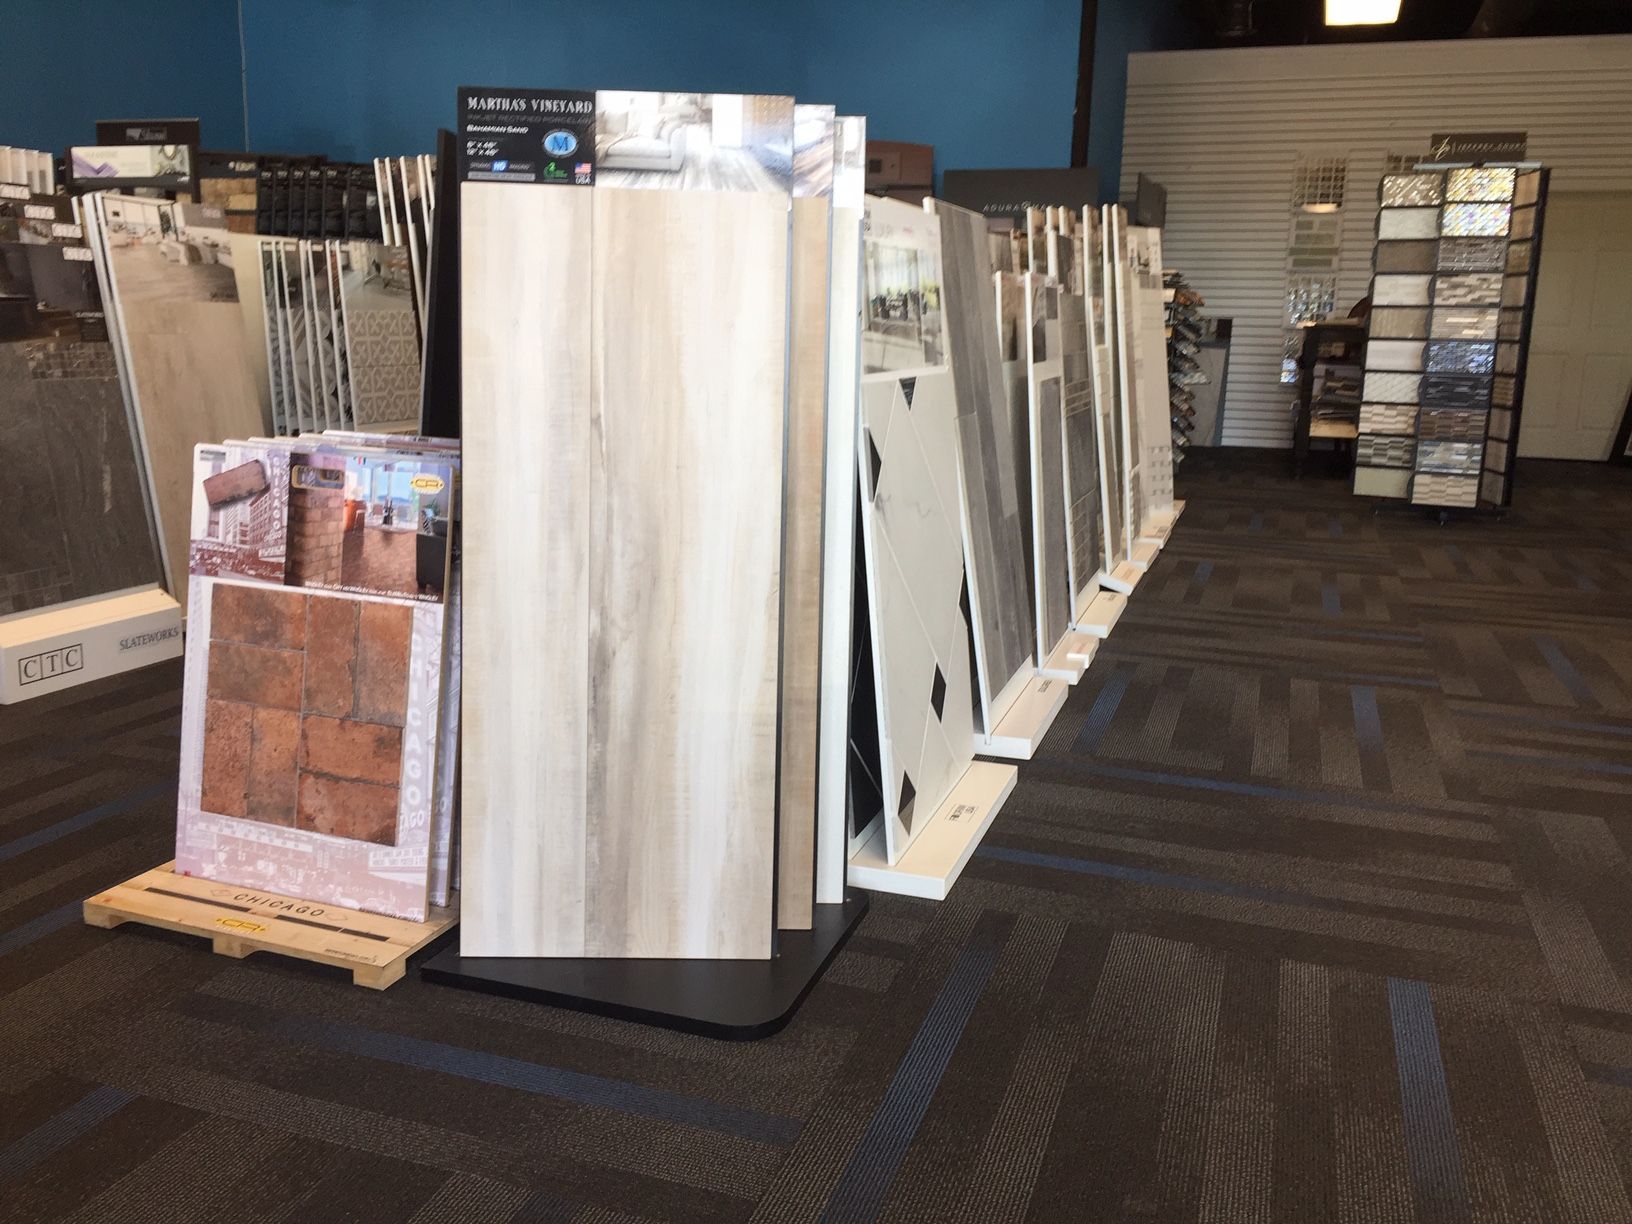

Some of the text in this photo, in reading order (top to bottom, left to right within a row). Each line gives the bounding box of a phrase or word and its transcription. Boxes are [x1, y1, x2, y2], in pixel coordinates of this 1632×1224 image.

[531, 99, 593, 114] VINEYARD
[273, 457, 282, 530] CHICAGO
[119, 626, 179, 650] SLATEWORKS
[23, 648, 79, 679] CTC
[233, 893, 325, 917] CHICAGO
